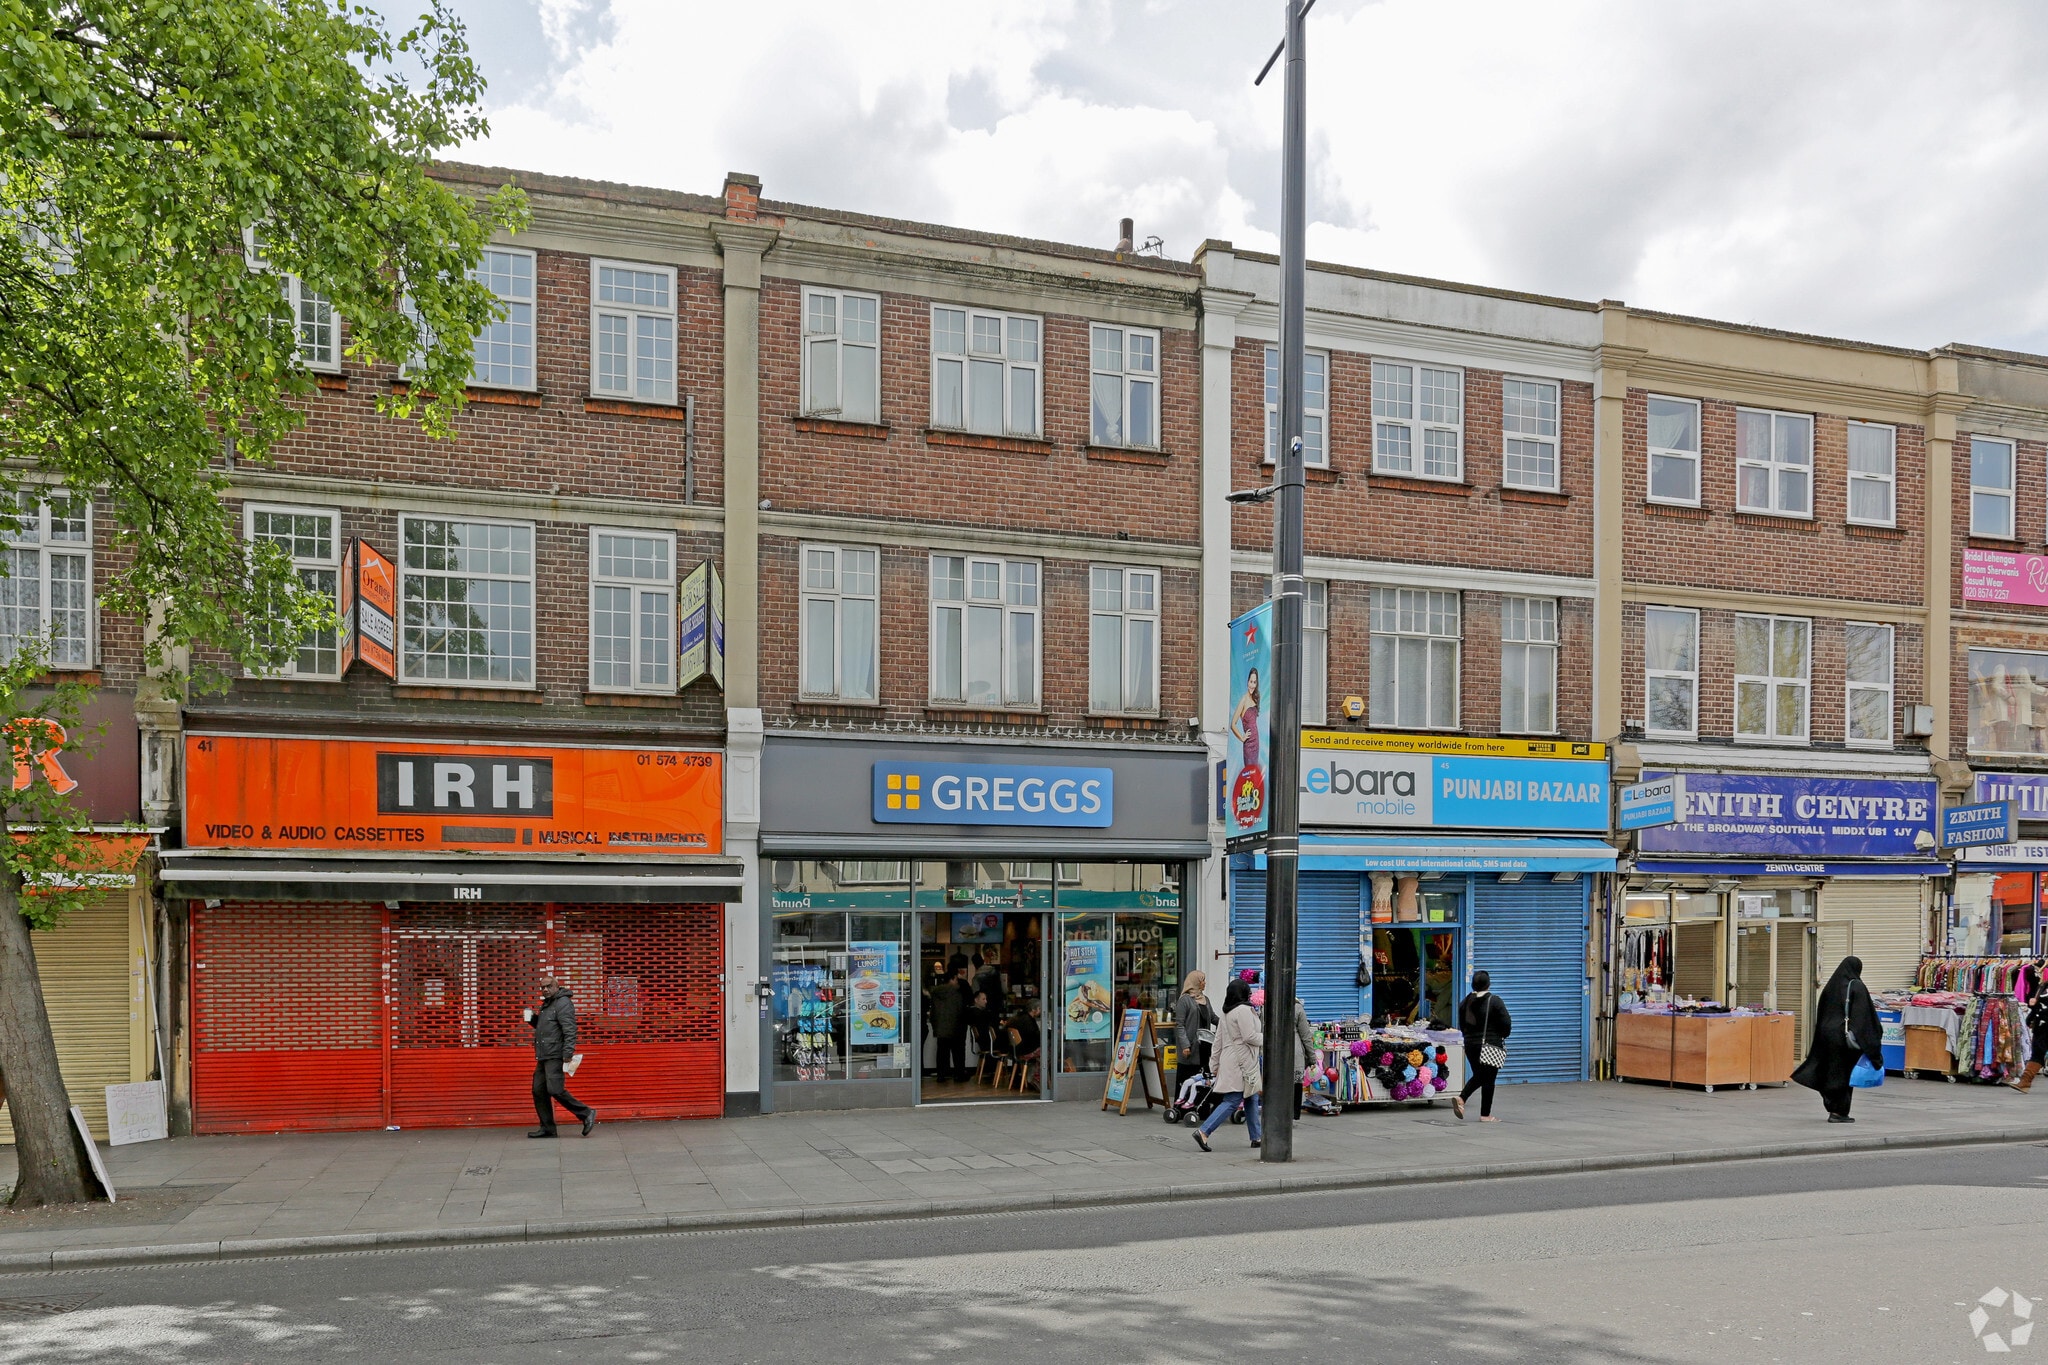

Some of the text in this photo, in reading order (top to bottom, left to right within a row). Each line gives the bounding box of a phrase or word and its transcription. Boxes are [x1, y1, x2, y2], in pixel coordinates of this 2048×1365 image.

[1964, 550, 2016, 566] Bridal Lehengas
[1964, 563, 2019, 577] Groom Sherwanis
[362, 569, 391, 600] Orange
[1964, 575, 2004, 587] Casual Wear
[1964, 587, 1976, 597] 020
[1978, 588, 1993, 598] 8574
[198, 740, 213, 752] 41
[1309, 735, 1504, 752] Send and receive money worldwide from here
[637, 754, 712, 767] 01 574 4739
[1440, 762, 1450, 770] 45
[931, 775, 1101, 814] GREGGS
[1442, 778, 1522, 801] PUNJABI
[1527, 781, 1600, 803] BAZAAR
[1632, 784, 1671, 800] Lebara
[1356, 799, 1416, 816] mobile
[1624, 806, 1671, 822] PUNJABI BAZAAR
[1685, 792, 1927, 822] ENITH CENTRE
[1950, 806, 2002, 824] ZENITH
[205, 824, 706, 845] VIDEO & AUDIO CASSETTES MUSICAL INSTRUMENTS
[1684, 824, 1704, 832] THE
[1708, 824, 1766, 834] BROADWAY
[1768, 825, 1825, 834] SOUTHALL
[1832, 826, 1865, 836] MIDDX
[1868, 827, 1886, 836] UB1
[1894, 828, 1912, 836] 1JY
[1947, 826, 2005, 844] FASHION
[1986, 844, 2017, 856] SIGHT
[1366, 858, 1378, 866] Low
[1420, 860, 1464, 868] international
[1464, 860, 1482, 868] calls,
[1484, 860, 1498, 868] SMS
[1500, 860, 1512, 868] and
[1513, 860, 1528, 868] data
[1765, 864, 1825, 872] ZENITH CENTRE
[454, 888, 482, 900] IRH
[857, 960, 883, 968] LUNCH
[120, 1110, 128, 1127] 4
